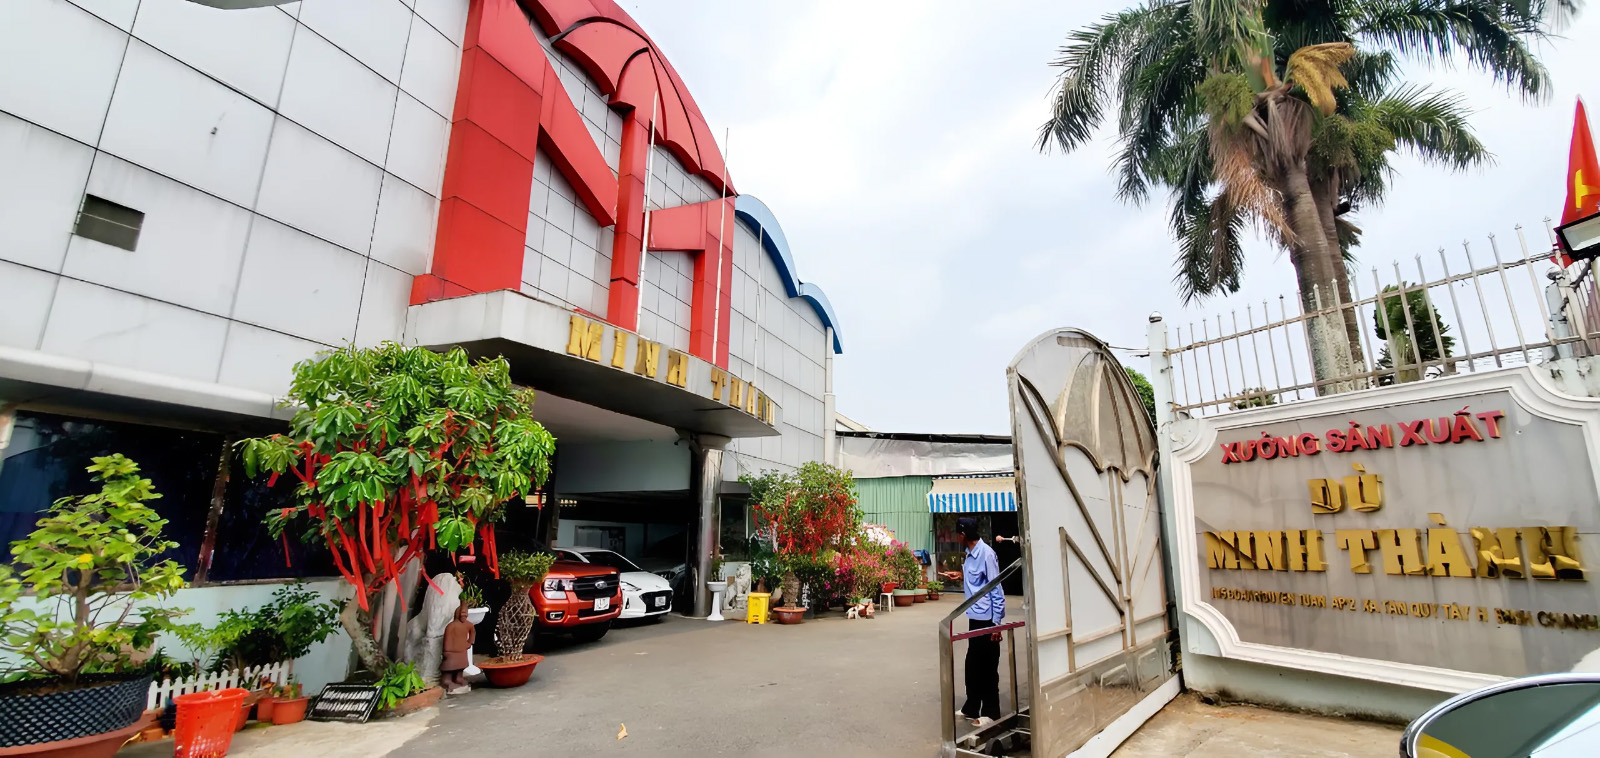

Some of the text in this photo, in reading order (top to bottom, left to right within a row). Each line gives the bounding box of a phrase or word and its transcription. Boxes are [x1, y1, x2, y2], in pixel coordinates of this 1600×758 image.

[567, 315, 689, 388] MINH
[1397, 405, 1505, 447] XUẤT
[1203, 512, 1590, 582] MINH THÀNH
